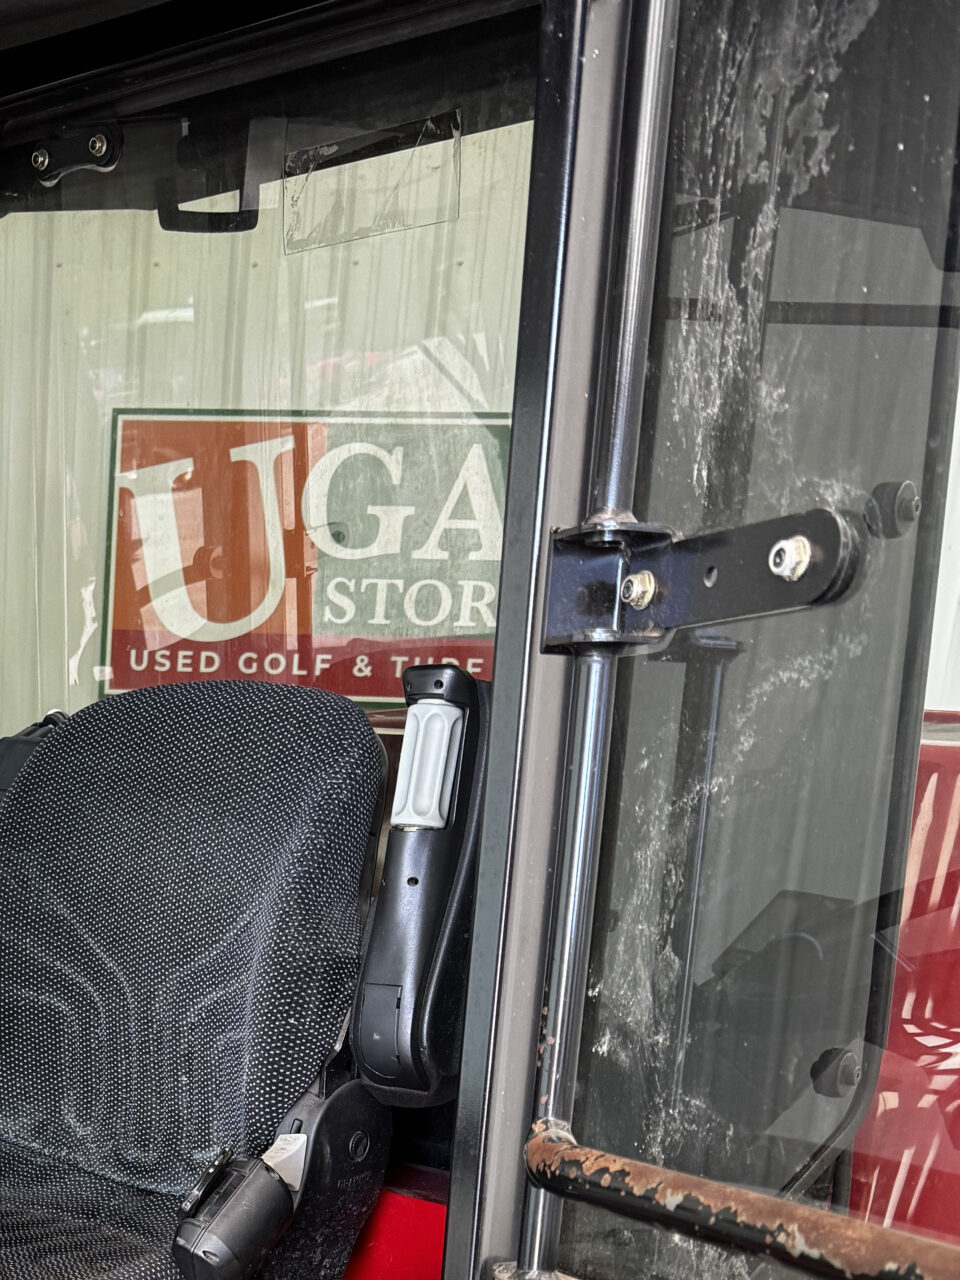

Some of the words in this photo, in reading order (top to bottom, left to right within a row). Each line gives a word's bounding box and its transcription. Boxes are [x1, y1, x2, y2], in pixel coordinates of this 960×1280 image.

[324, 577, 497, 628] STOR
[129, 649, 221, 673] USED
[237, 652, 334, 677] GOLF
[352, 654, 373, 678] &
